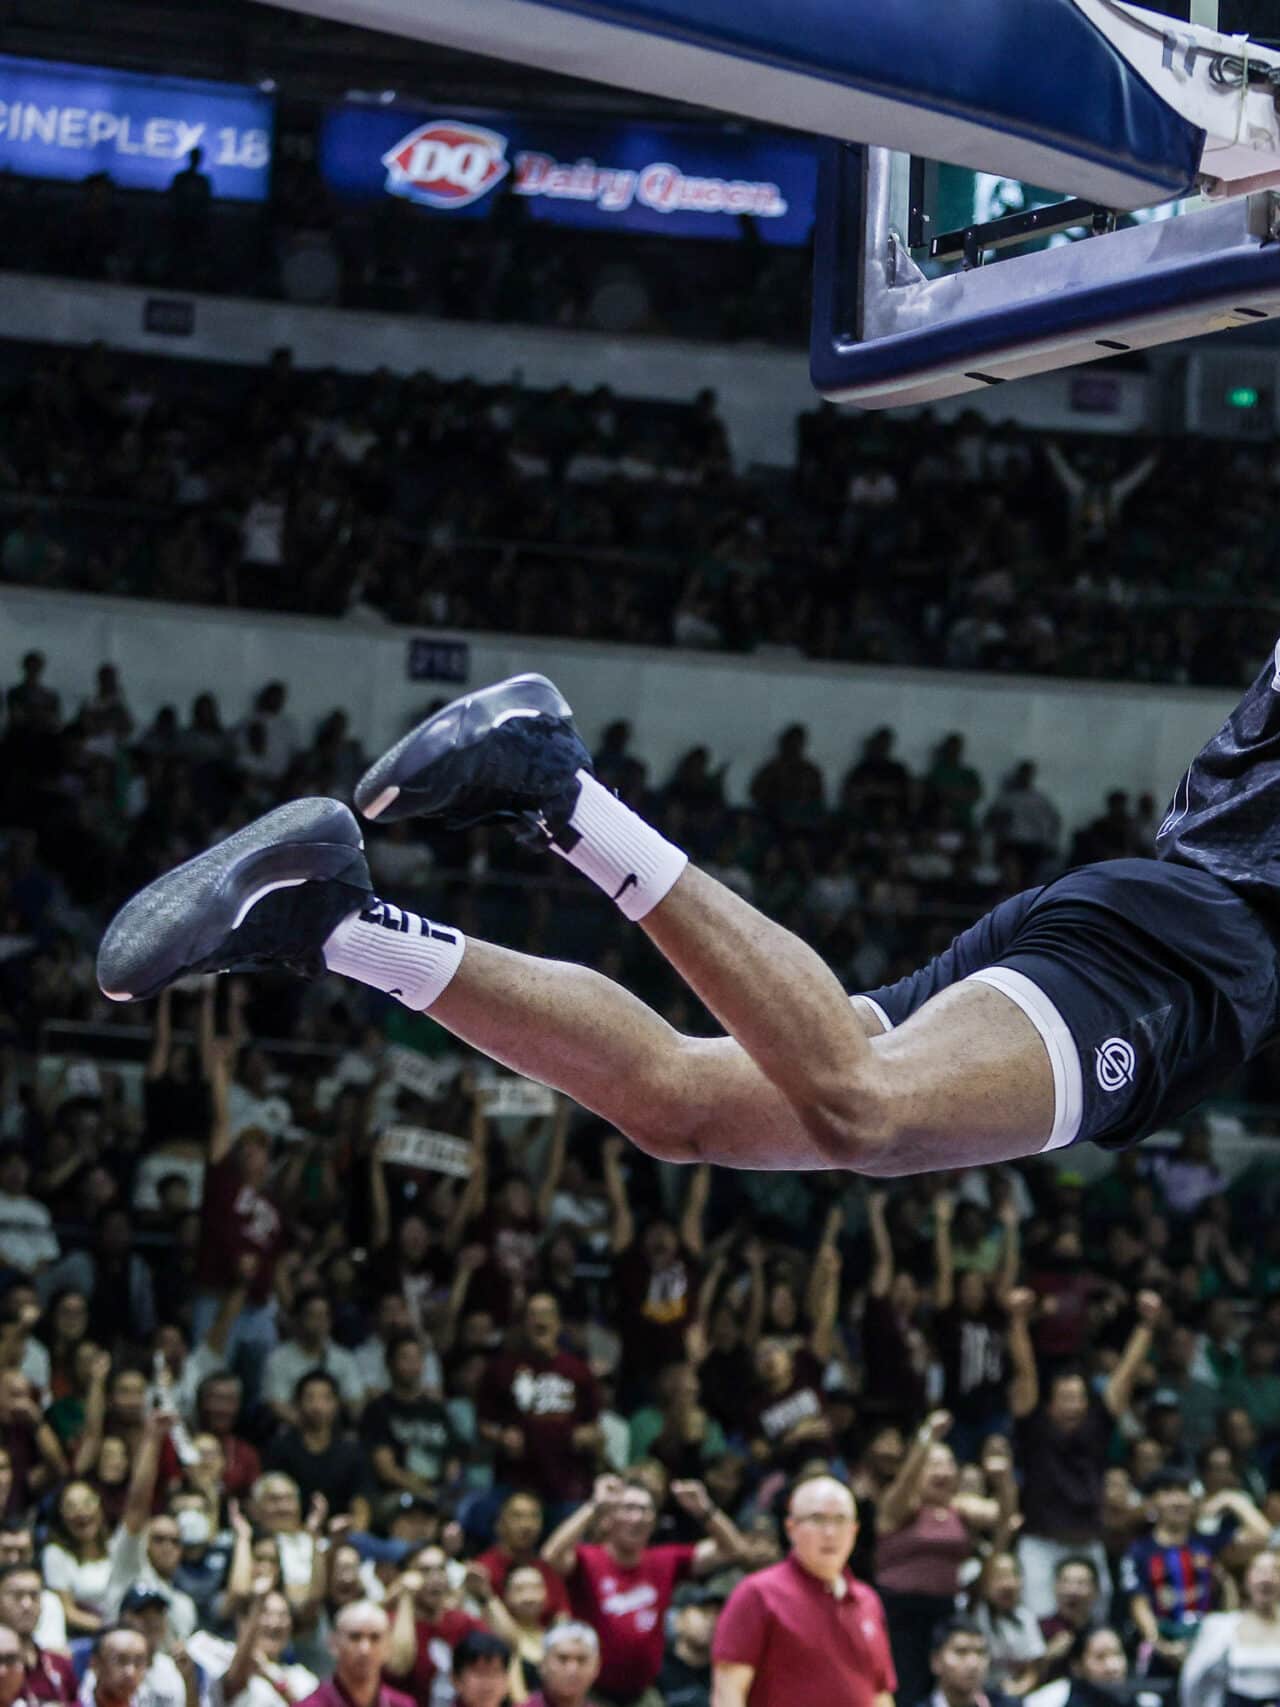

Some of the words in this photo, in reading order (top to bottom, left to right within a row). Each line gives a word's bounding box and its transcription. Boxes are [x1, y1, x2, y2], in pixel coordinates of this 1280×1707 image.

[215, 127, 268, 169] 18
[410, 138, 492, 184] DQ
[514, 152, 636, 210] Dairy
[360, 897, 456, 945] ELI
